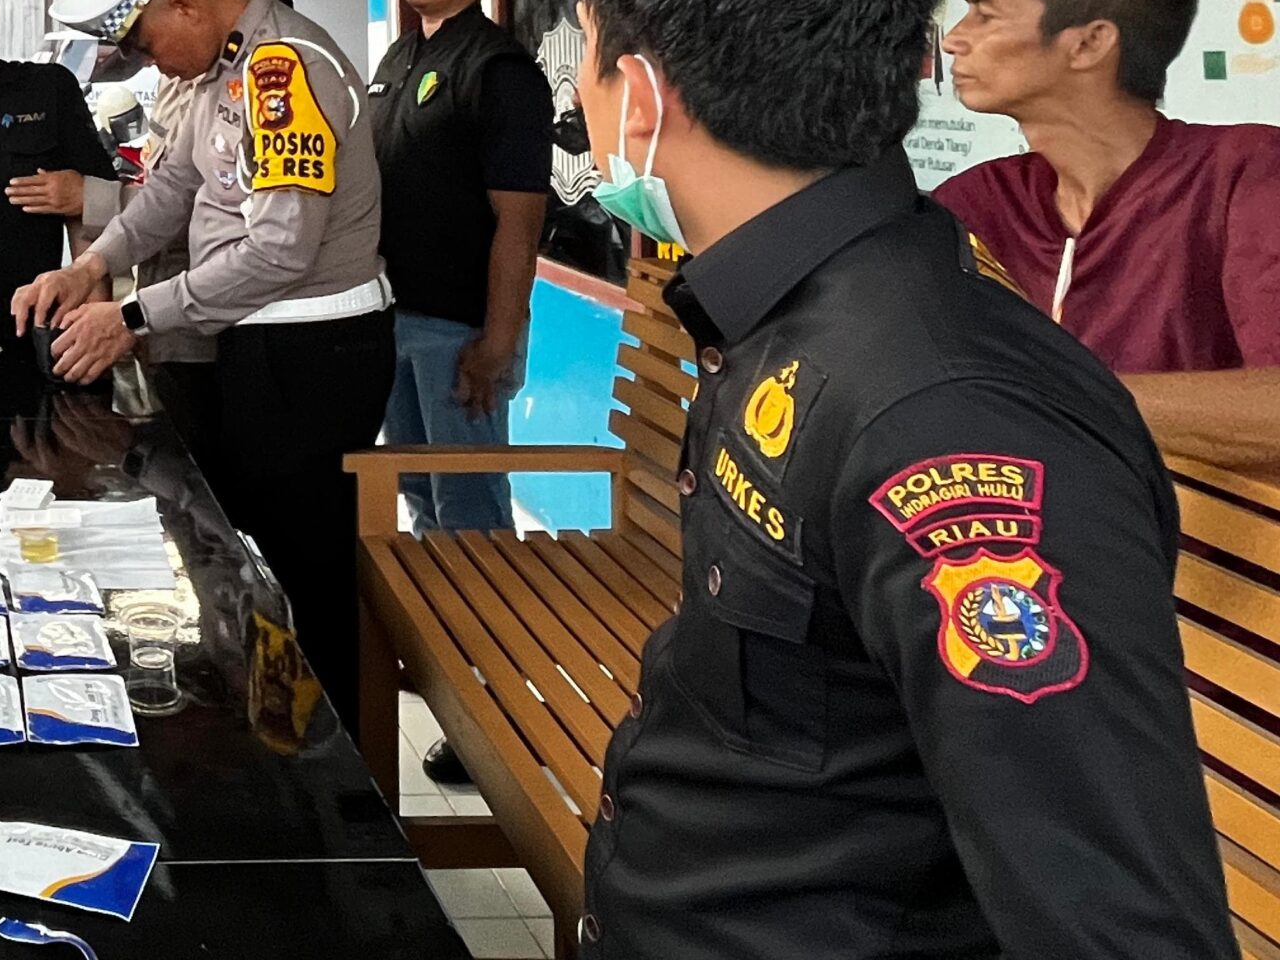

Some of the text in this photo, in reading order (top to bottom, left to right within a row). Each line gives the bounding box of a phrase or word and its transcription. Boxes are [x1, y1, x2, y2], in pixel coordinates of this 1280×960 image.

[16, 111, 47, 124] TAM
[262, 132, 325, 157] POSKO
[283, 157, 325, 180] RES
[715, 447, 785, 541] URKES
[886, 462, 1025, 508] POLRES
[899, 482, 1024, 520] INDRAGIRI HULU
[927, 519, 1019, 548] RIAU
